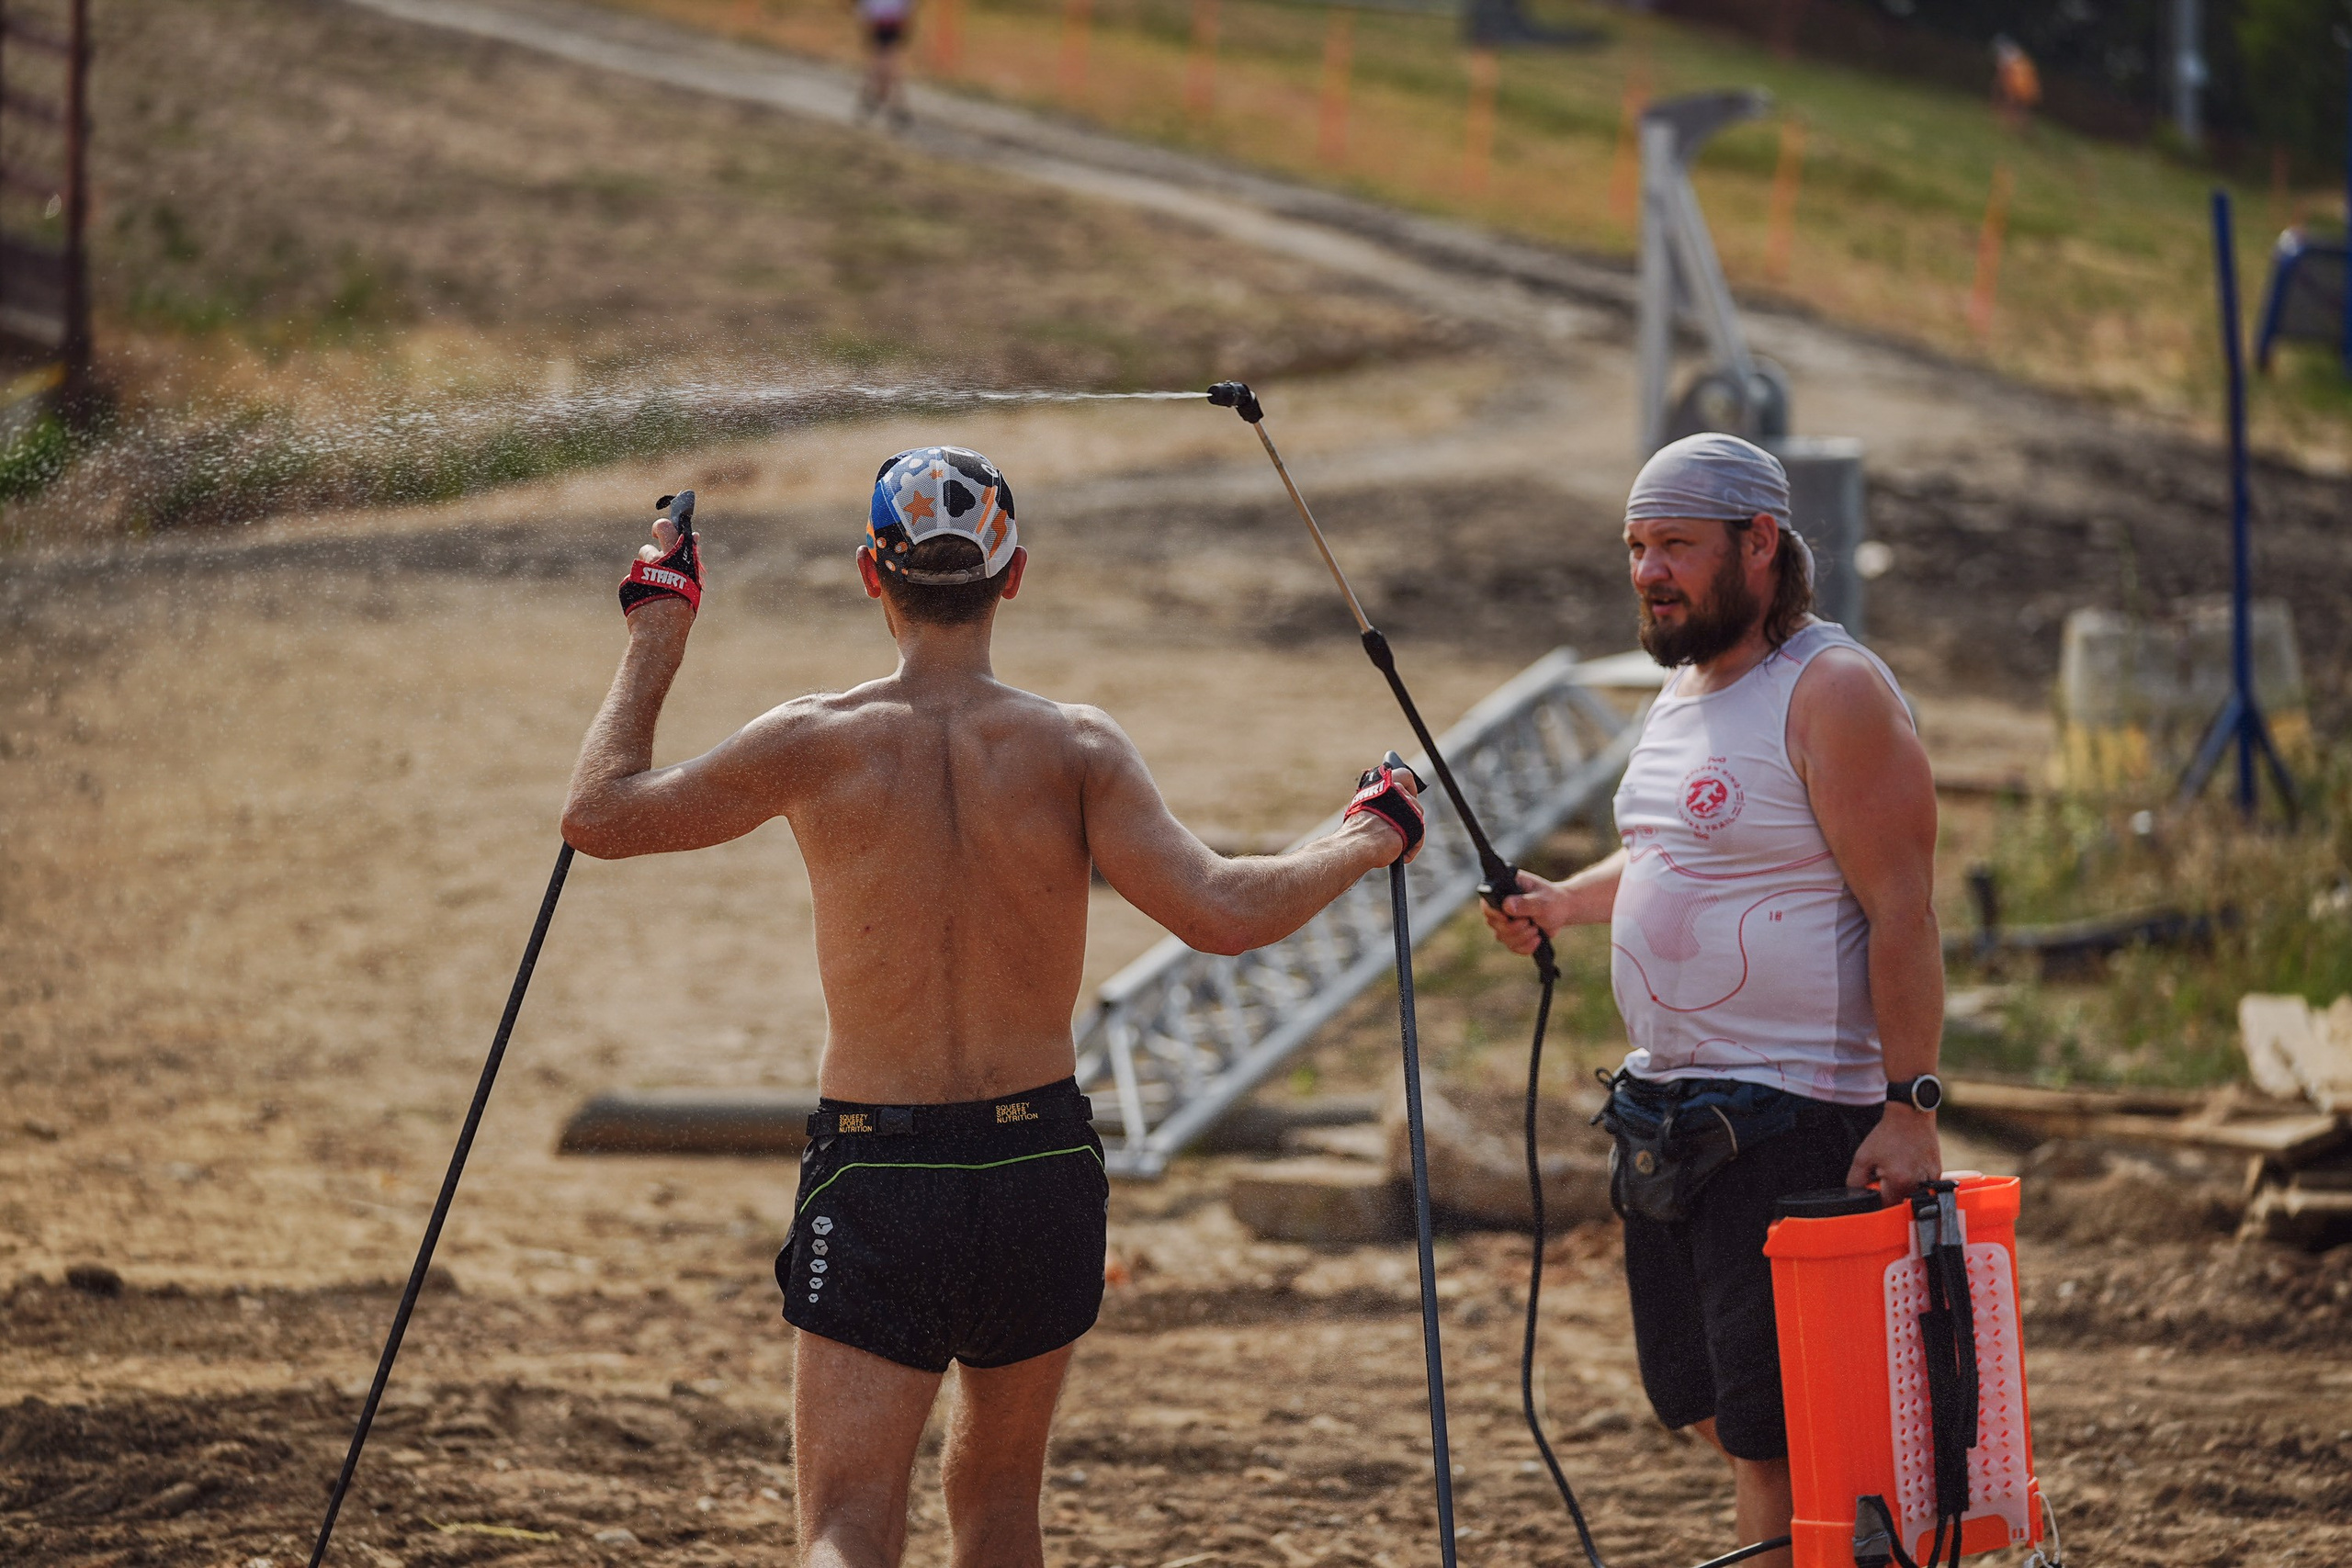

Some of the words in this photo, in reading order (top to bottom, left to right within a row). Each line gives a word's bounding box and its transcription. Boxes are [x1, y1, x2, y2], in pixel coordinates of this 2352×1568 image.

[640, 566, 687, 590] START
[995, 1101, 1030, 1111] SQUEEZY
[839, 1113, 868, 1122] SQUEEZY
[996, 1108, 1027, 1118] SPORTS
[996, 1112, 1039, 1123] NUTRITION
[839, 1125, 873, 1134] NUTRITION
